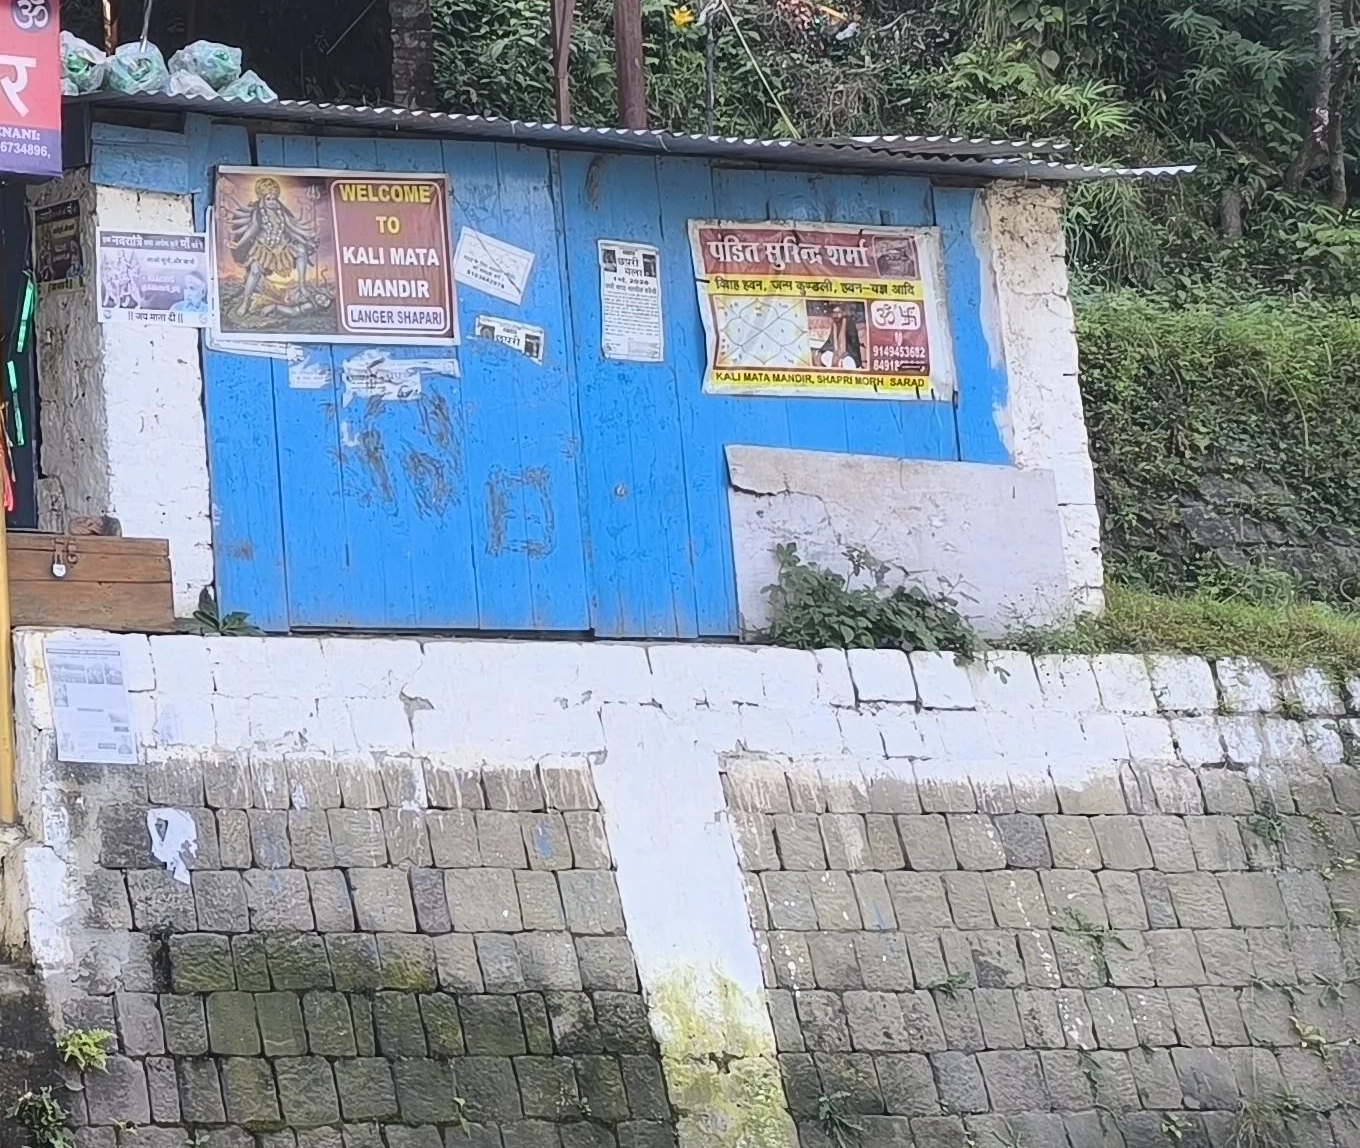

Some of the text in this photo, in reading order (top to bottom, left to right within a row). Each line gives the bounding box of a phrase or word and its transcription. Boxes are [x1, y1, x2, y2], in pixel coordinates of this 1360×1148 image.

[339, 184, 431, 203] WELCOME
[376, 216, 400, 233] TO
[343, 246, 439, 266] KALI MATA
[707, 234, 760, 263] पंडित
[824, 239, 870, 267] शर्मा
[358, 279, 430, 298] MANDIR
[891, 281, 914, 295] आदि
[135, 312, 148, 321] जय
[150, 313, 166, 322] माता
[168, 311, 176, 323] दी
[350, 309, 441, 325] LANGER SHAPARI
[716, 372, 925, 387] KALI MATA MANDIR, SHAPRI MORH SARAD
